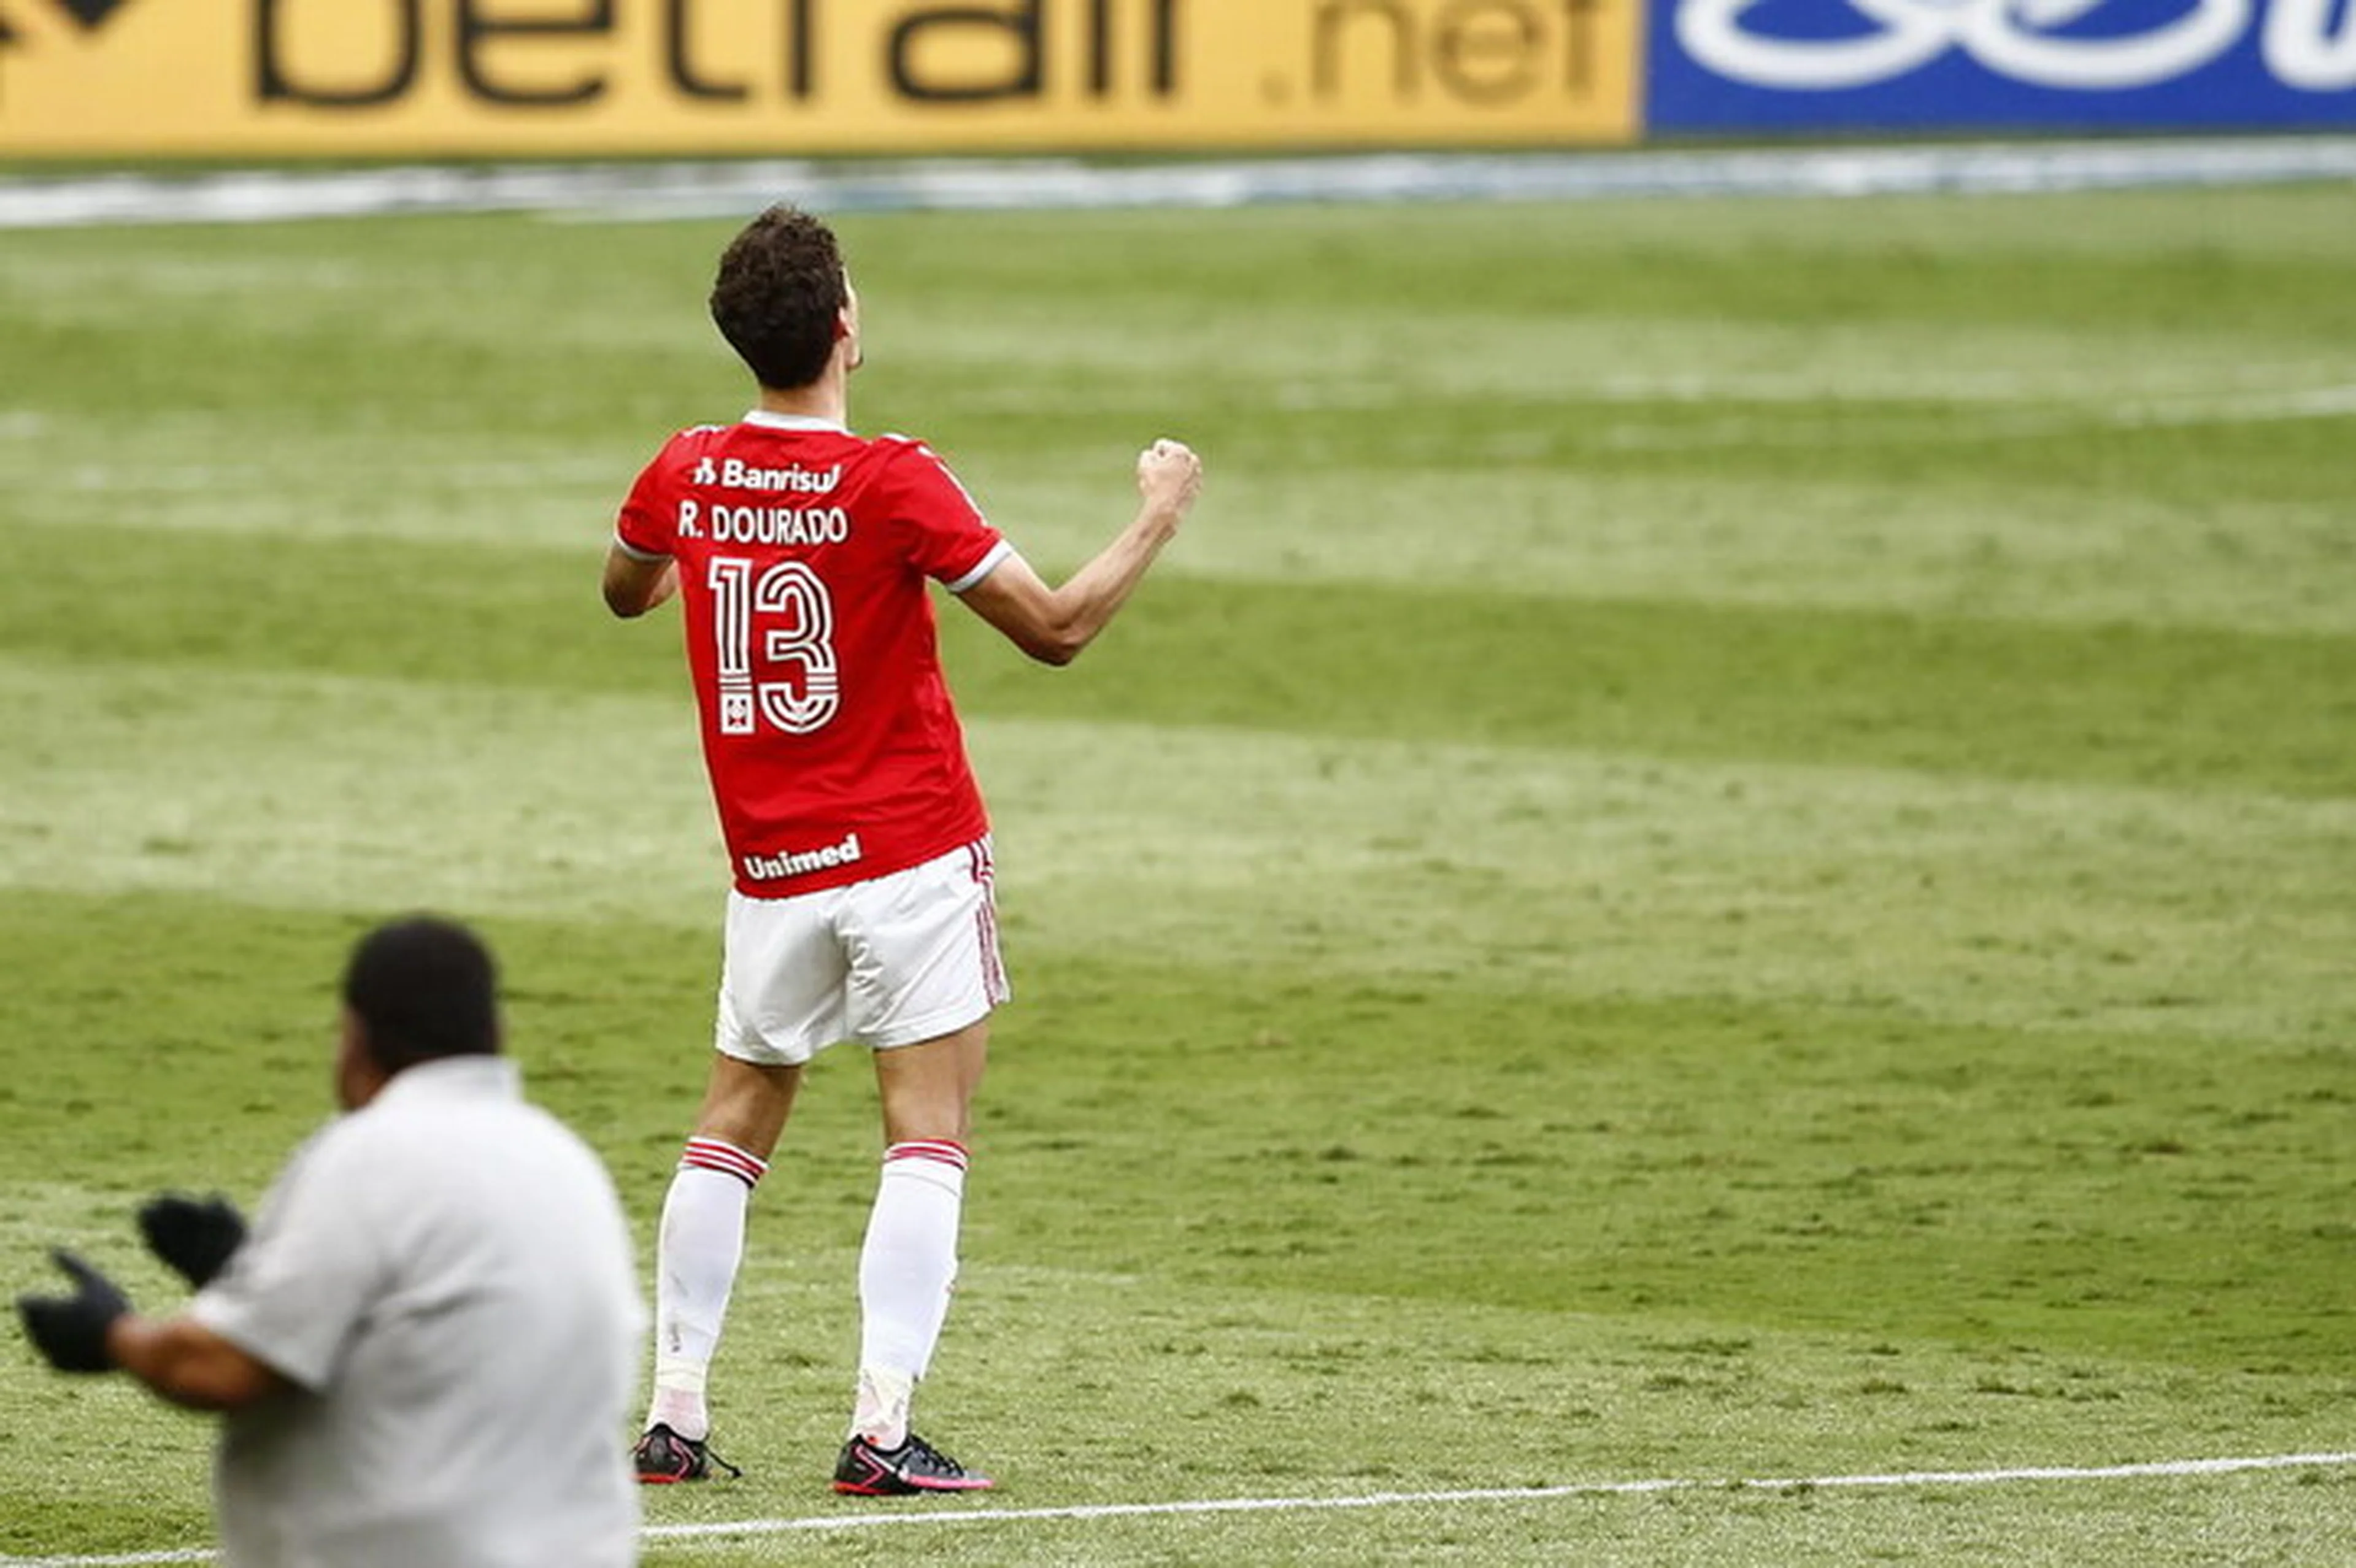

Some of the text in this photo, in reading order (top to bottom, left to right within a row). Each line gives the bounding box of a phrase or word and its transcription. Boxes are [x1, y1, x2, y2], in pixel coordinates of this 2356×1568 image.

[722, 458, 842, 493] Banrisul
[678, 499, 848, 545] R. DOURADO
[709, 557, 839, 734] 13
[744, 833, 860, 880] Unimed
